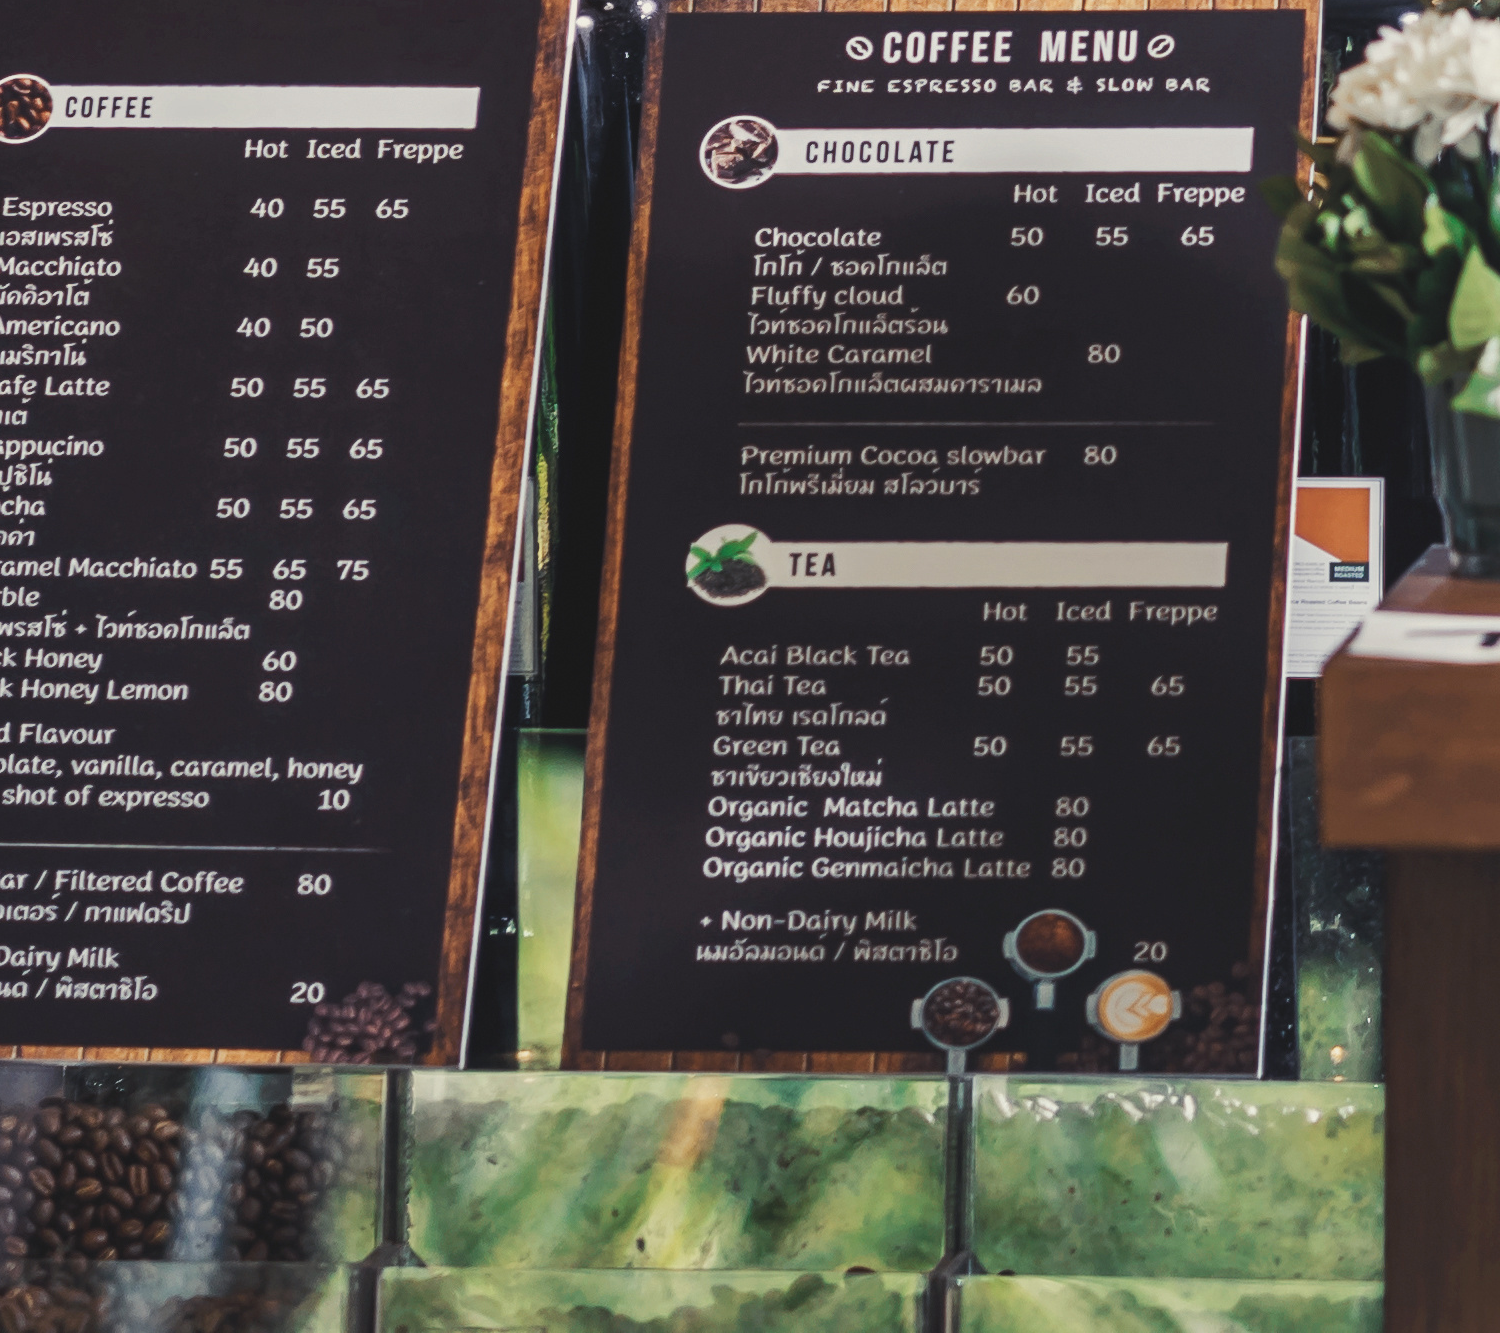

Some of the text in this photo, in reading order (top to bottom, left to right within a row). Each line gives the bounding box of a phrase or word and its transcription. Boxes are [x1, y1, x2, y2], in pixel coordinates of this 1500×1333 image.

[882, 29, 1139, 64] COFFEE MENU
[816, 75, 1211, 95] FINE ESPRESSO BAR & SLOW BAR
[65, 96, 154, 119] COFFEE
[244, 137, 465, 165] Hot Iced Freppe
[805, 140, 955, 164] CHOCOLATE
[1013, 181, 1246, 208] Hot Iced Freppe
[1, 196, 410, 226] Espresso 40 55 65
[754, 225, 1215, 248] Chocolate 50 55 65
[242, 257, 279, 278] 40
[305, 257, 340, 279] 55
[751, 284, 1041, 314] Fluffy cloud 60
[235, 316, 272, 338] 40
[298, 317, 334, 339] 50
[745, 343, 1121, 365] White Caramel 80
[44, 375, 111, 397] Latte
[229, 376, 265, 398] 50
[292, 377, 327, 399] 55
[355, 377, 390, 400] 65
[222, 437, 258, 459] 50
[285, 437, 321, 459] 55
[348, 437, 384, 460] 65
[740, 444, 1118, 466] Premium Cocoa slowbar 80
[215, 497, 251, 519] 50
[278, 498, 314, 520] 55
[341, 498, 377, 521] 65
[67, 556, 199, 579] Macchiato
[209, 558, 244, 580] 55
[271, 558, 307, 581] 65
[336, 559, 370, 582] 75
[789, 552, 836, 577] TEA
[268, 588, 304, 611] 80
[983, 600, 1218, 626] Hot Iced Freppe
[23, 647, 104, 675] Honey
[261, 649, 298, 672] 60
[719, 644, 1100, 666] Acai Black Tea 50 55
[20, 677, 100, 705] Honey
[105, 678, 190, 701] Lemon
[257, 680, 294, 703] 80
[718, 674, 1185, 697] Thai Tea 50 55 65
[18, 722, 118, 745] Flavour
[712, 735, 1181, 757] Green Tea 50 55 65
[70, 754, 163, 781] vanilla,
[169, 756, 280, 782] caramel,
[286, 756, 364, 785] honey
[1, 783, 58, 806] shot
[63, 784, 94, 807] of
[97, 789, 211, 813] expresso
[317, 788, 352, 811] 10
[707, 795, 1090, 823] Organic Matcha Latte 80
[704, 825, 1088, 853] Organic Houjicha Latte 80
[702, 855, 1086, 884] Organic Genmaicha Latte 80
[51, 868, 154, 893] Filtered
[159, 870, 245, 895] Coffee
[296, 873, 333, 896] 80
[721, 909, 917, 939] Non-Dairy Milk
[66, 946, 120, 969] Milk
[1133, 941, 1168, 962] 20
[289, 981, 326, 1005] 20
